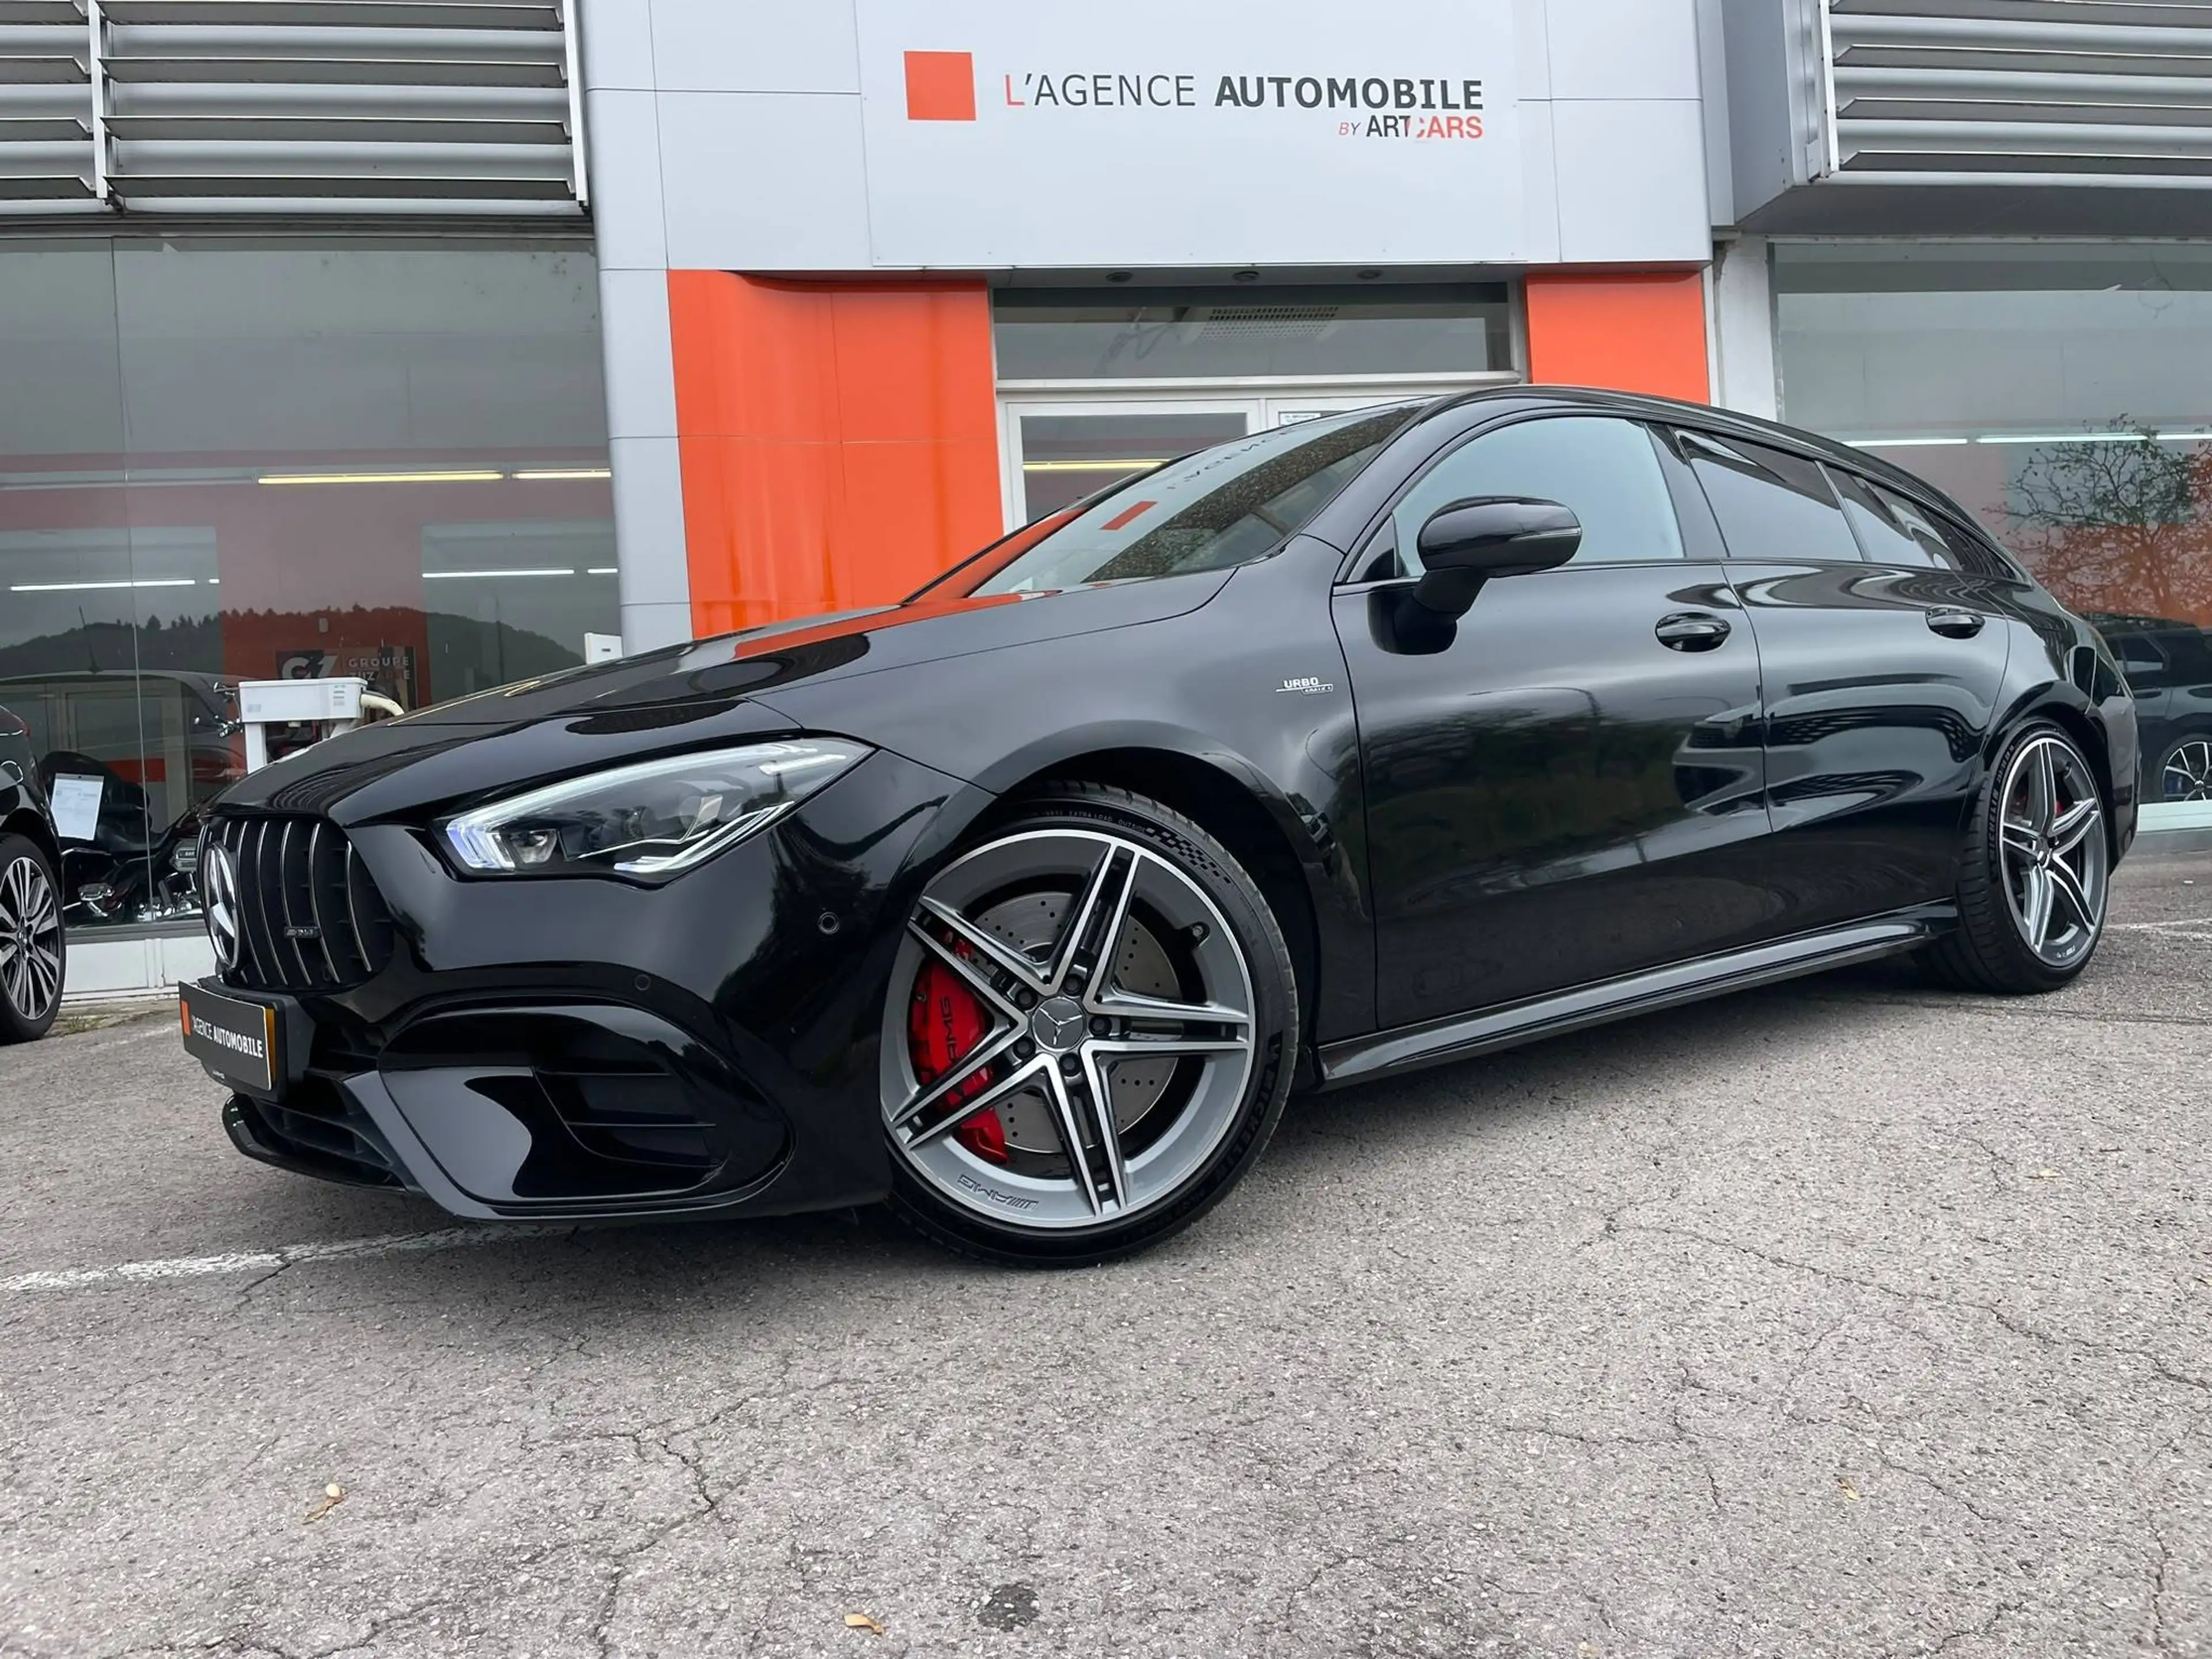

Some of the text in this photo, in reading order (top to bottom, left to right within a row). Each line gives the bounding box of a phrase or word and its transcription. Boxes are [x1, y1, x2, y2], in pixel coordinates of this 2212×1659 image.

[1005, 73, 1483, 110] L'AGENCE AUTOMOBILE
[1339, 122, 1361, 135] BY
[348, 656, 410, 668] GROUPE
[213, 1026, 263, 1059] AUTOMOBILE
